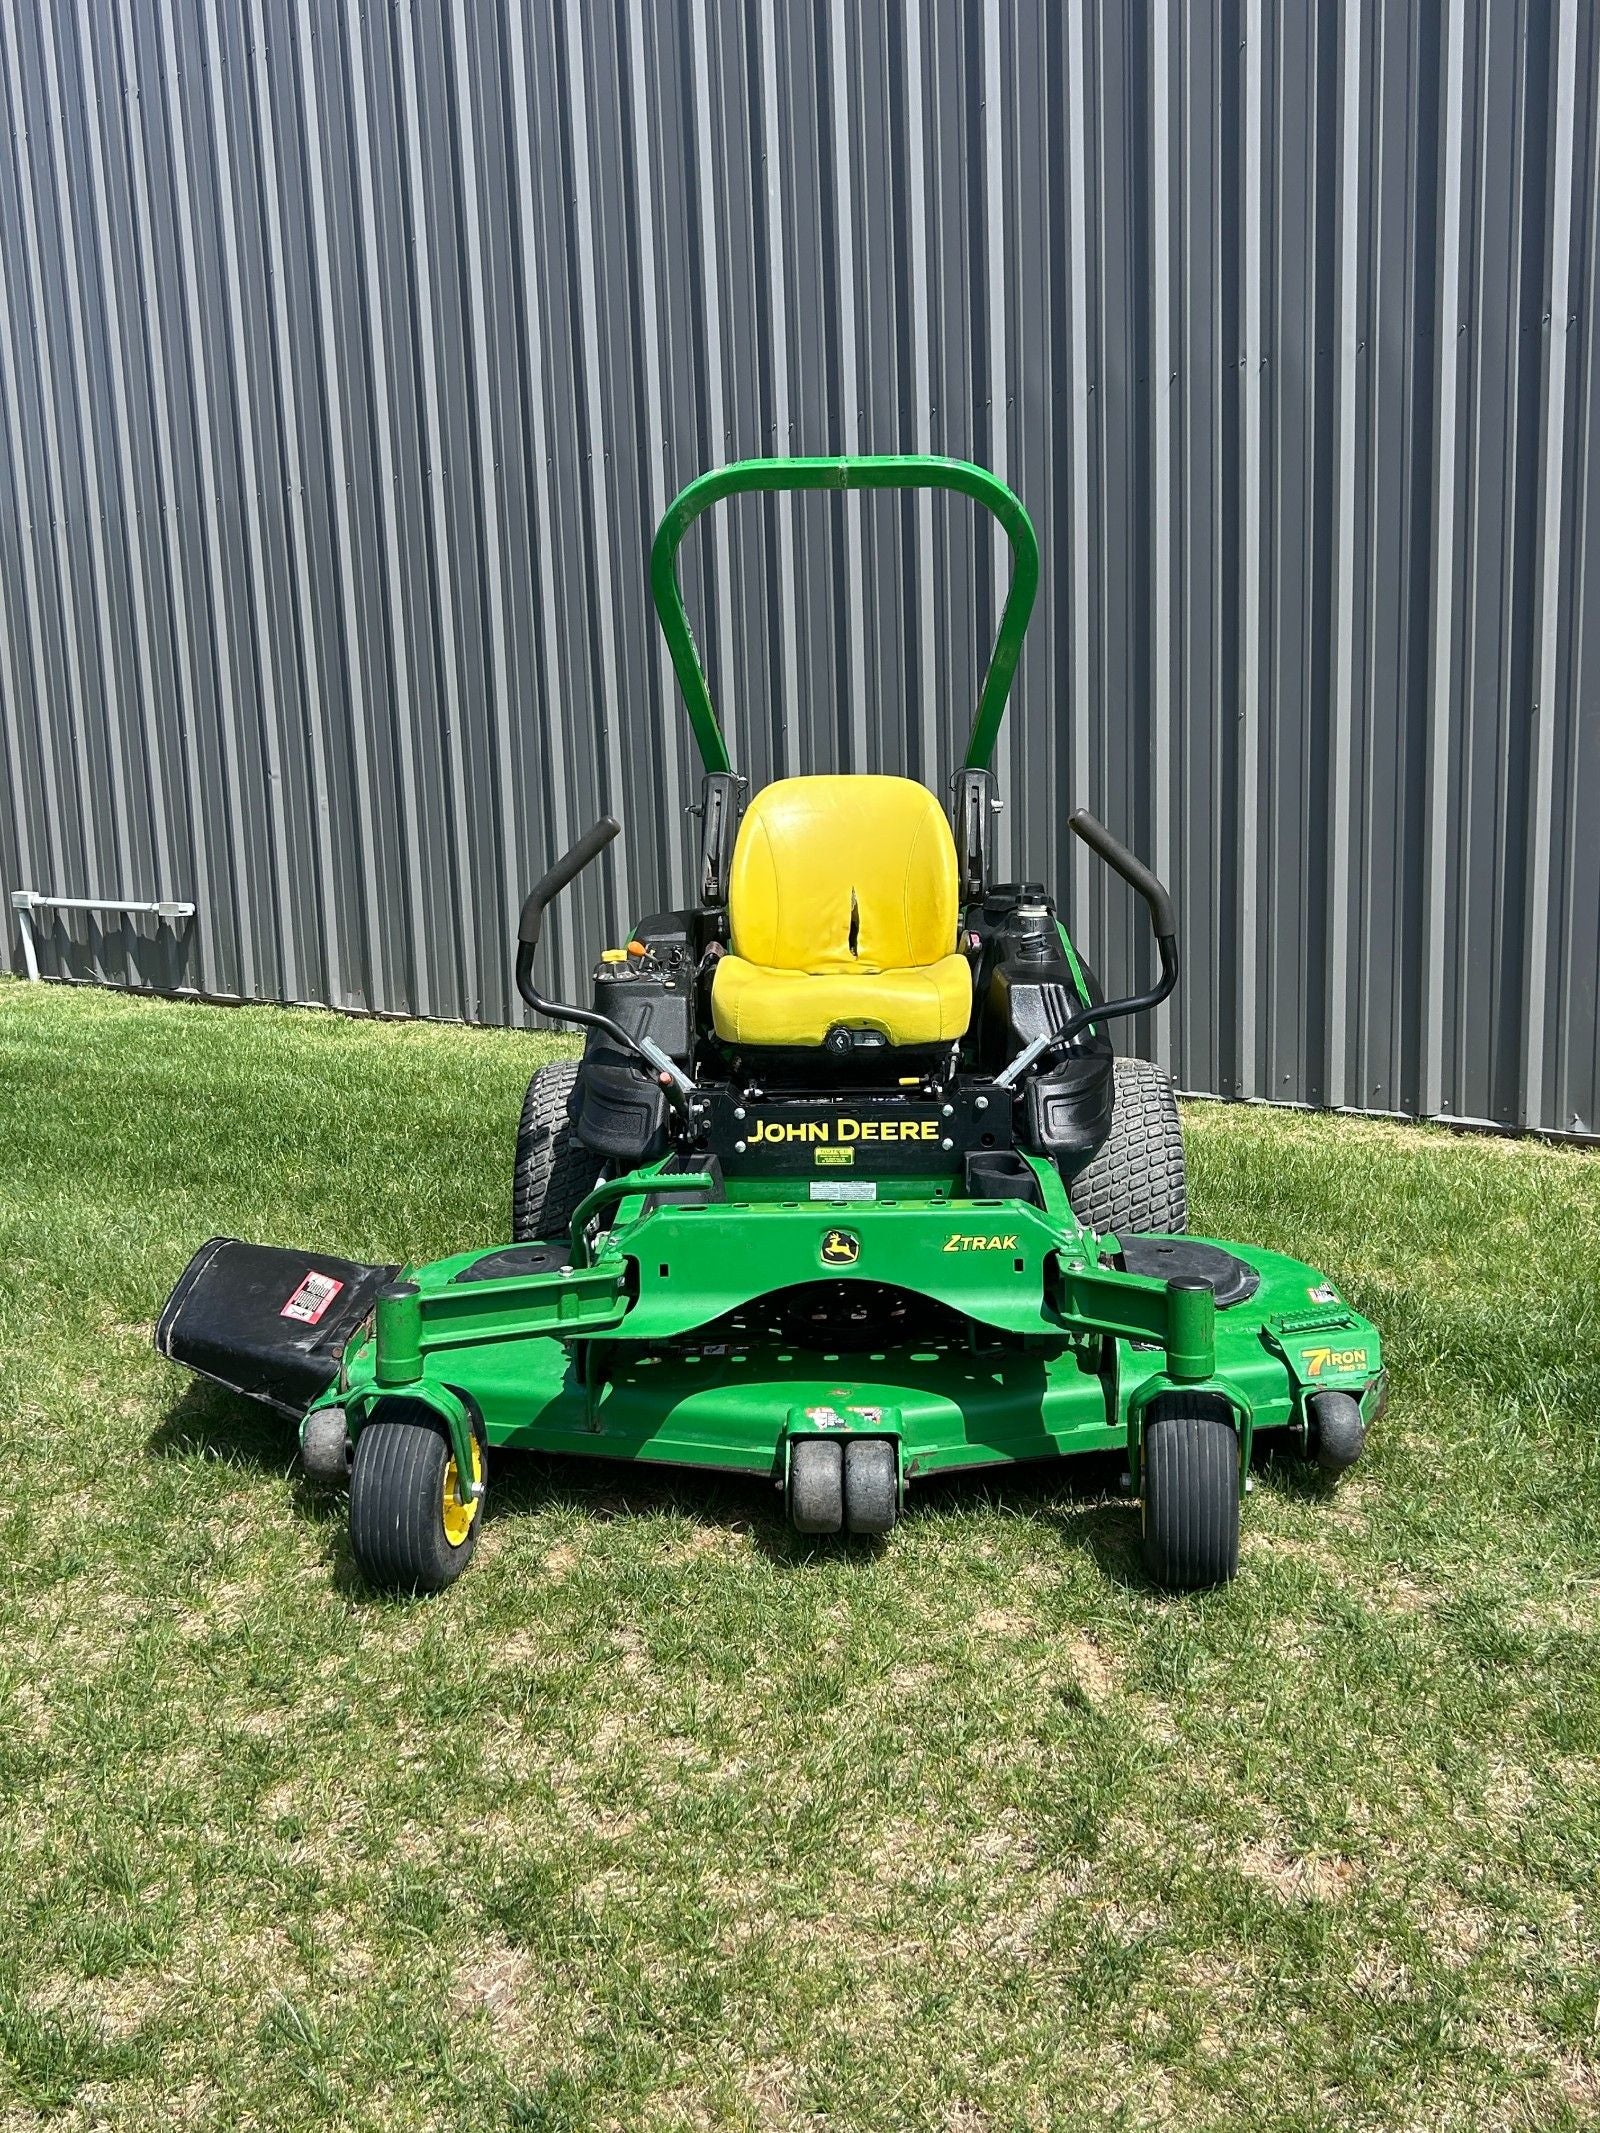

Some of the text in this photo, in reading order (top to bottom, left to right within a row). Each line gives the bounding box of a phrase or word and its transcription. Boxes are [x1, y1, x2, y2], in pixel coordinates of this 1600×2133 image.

[748, 1118, 939, 1143] JOHN DEERE
[943, 1234, 1018, 1252] ZTRAK
